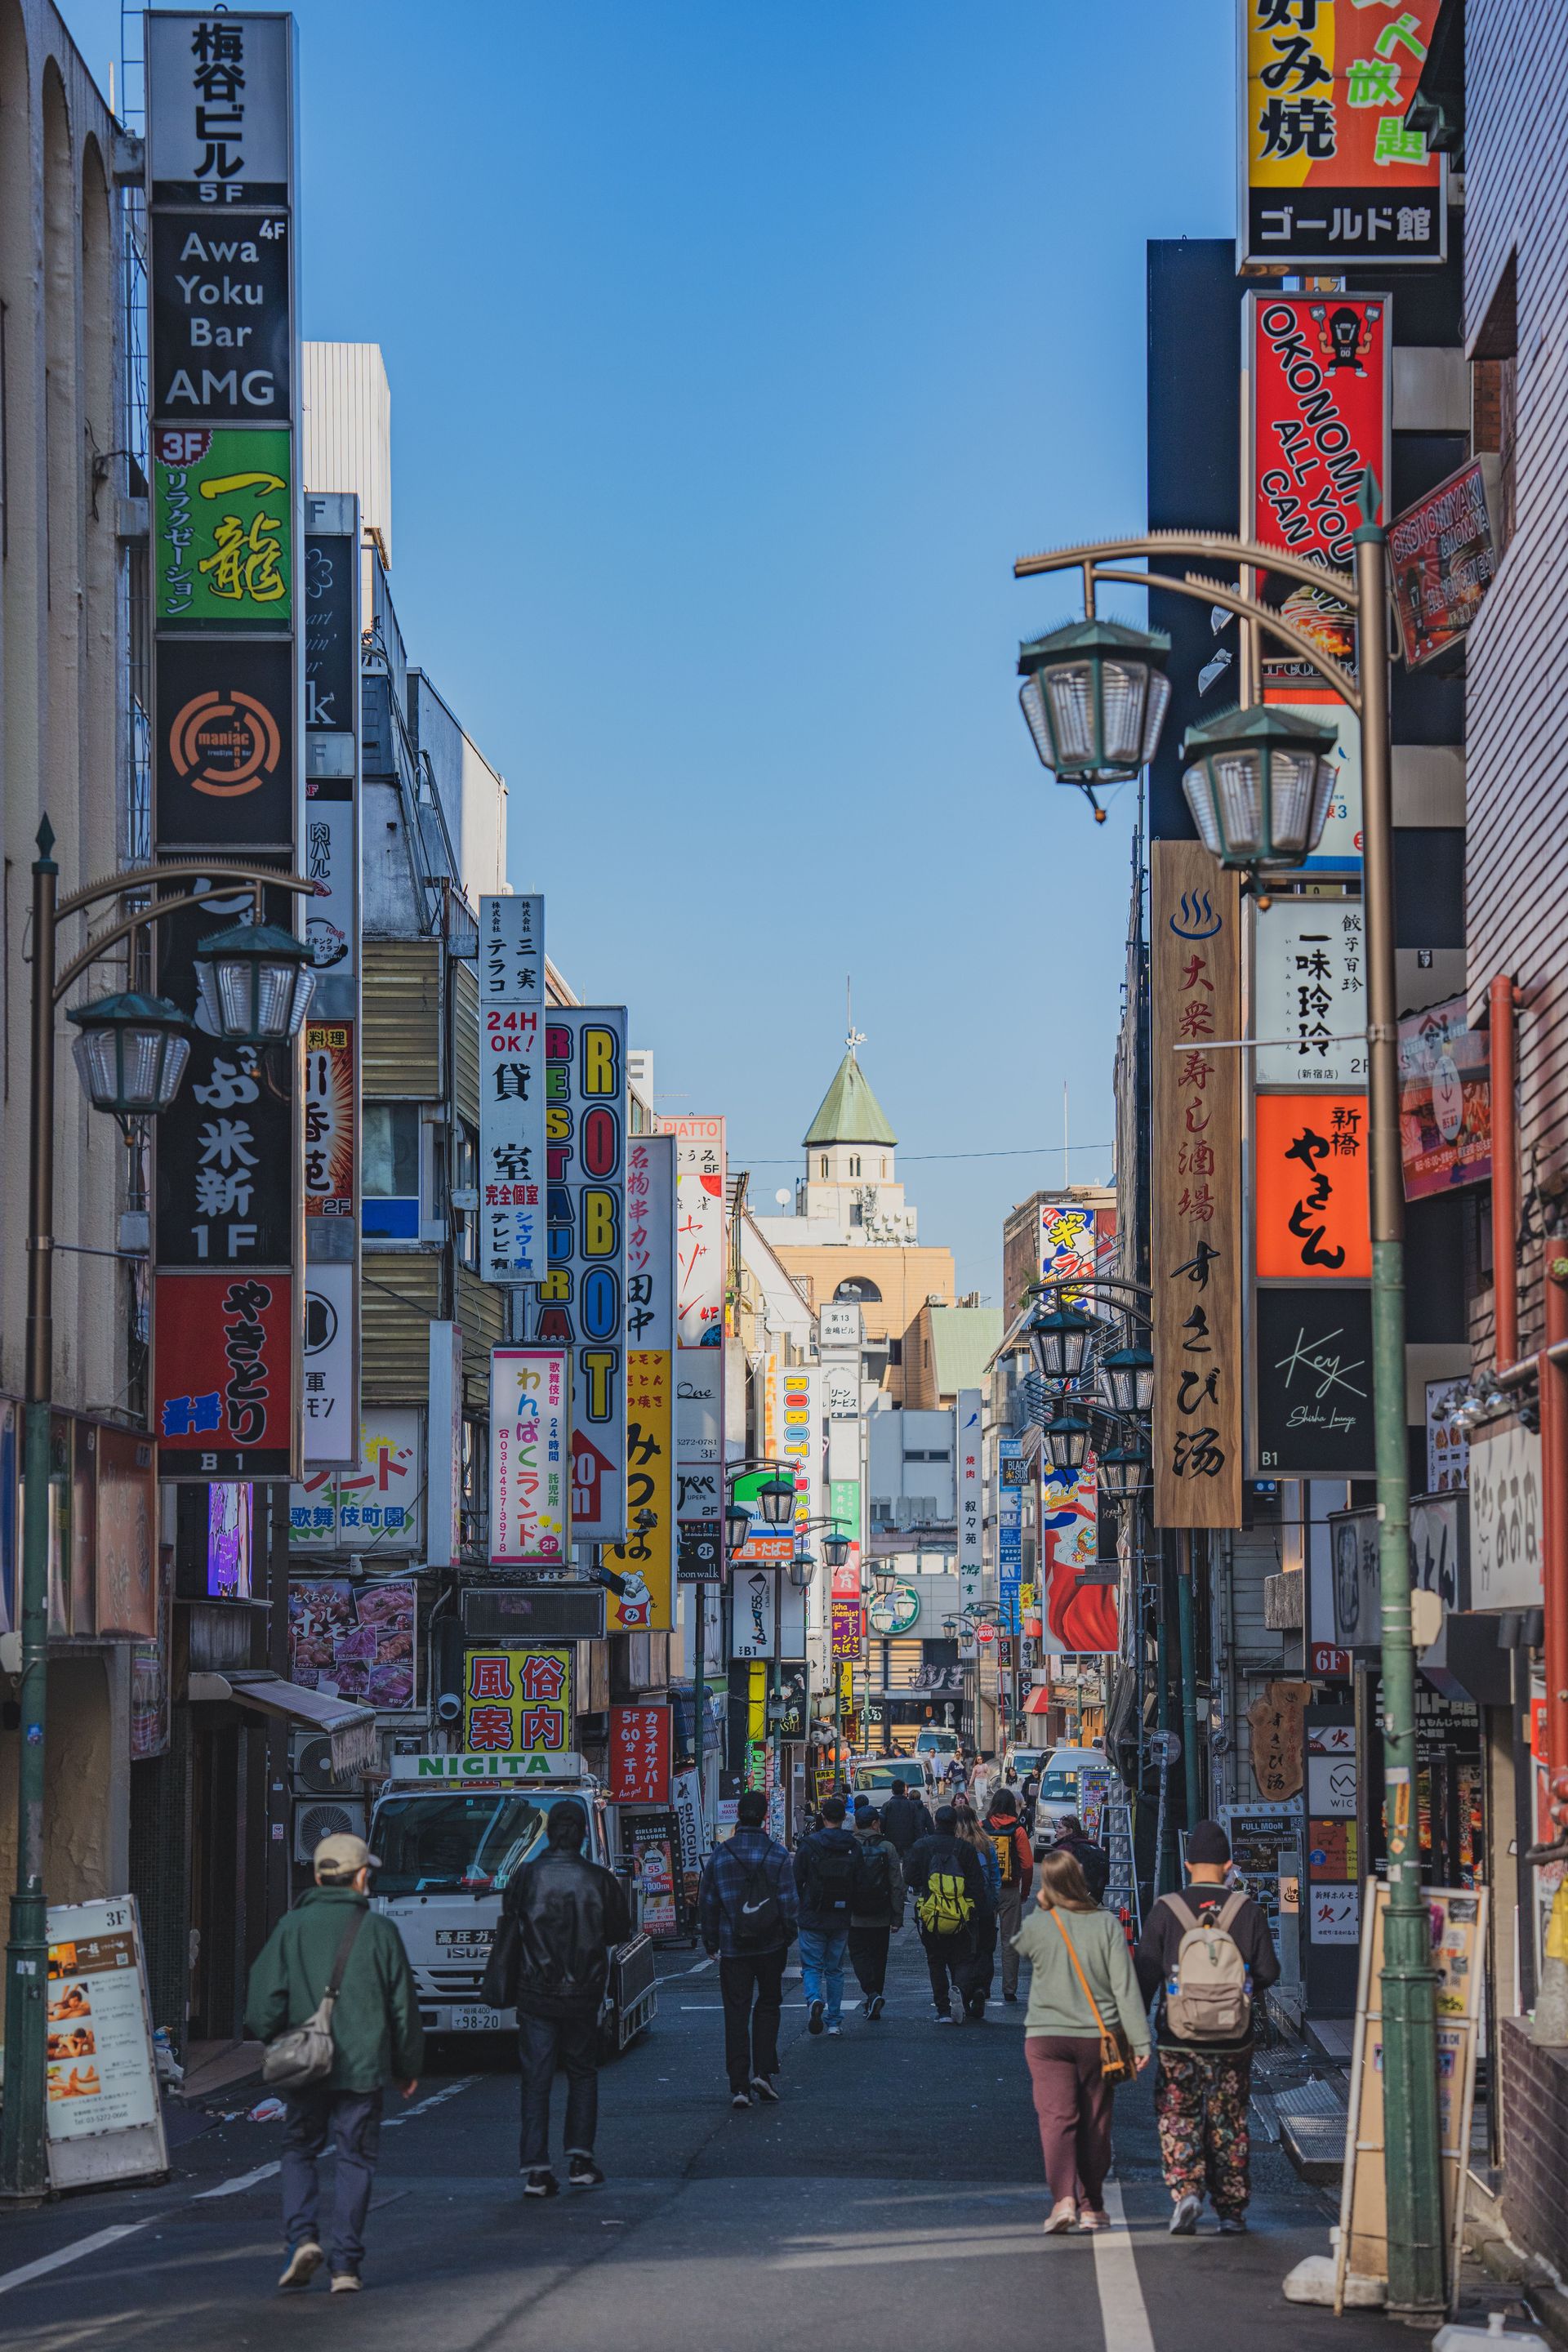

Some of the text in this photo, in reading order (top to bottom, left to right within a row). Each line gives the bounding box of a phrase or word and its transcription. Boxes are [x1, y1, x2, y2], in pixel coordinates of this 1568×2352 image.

[191, 23, 245, 179] 梅谷ビル
[198, 184, 243, 203] 5F
[259, 219, 285, 239] 4F
[1261, 207, 1431, 241] ゴールド館
[180, 232, 259, 263] Awa
[176, 275, 263, 305] Yoku
[190, 318, 252, 348] Bar
[166, 370, 274, 405] AMG
[163, 432, 202, 461] 3F
[1261, 468, 1314, 546] CAN
[1272, 419, 1353, 564] ALL YOU
[1392, 471, 1483, 564] OKONOMIYAKI
[164, 472, 194, 614] リラクゼーション
[199, 471, 287, 603] 一龍
[198, 731, 249, 745] maniac
[310, 822, 330, 879] 肉バル
[523, 901, 532, 933] 株式会社
[487, 901, 507, 992] 株式会社 テラコ
[1341, 913, 1365, 994] 餃子百珍
[1296, 933, 1333, 1057] 一味玲玲
[487, 1012, 537, 1031] 24H
[491, 1035, 534, 1052] OK!
[1177, 955, 1215, 1223] 大衆寿し酒場
[492, 1063, 532, 1181] 貸室
[664, 1122, 718, 1137] PIATTO
[1330, 1107, 1361, 1157] 新橋
[703, 1165, 719, 1173] 5F
[323, 1200, 350, 1215] 2F
[485, 1184, 539, 1206] 完全個室
[1285, 1127, 1345, 1269] やきとん
[581, 1023, 620, 1423] ROBOT
[192, 1225, 256, 1258] 1F
[490, 1213, 510, 1270] テレビ有
[514, 1211, 533, 1270] シャワー有
[627, 1146, 654, 1342] 名物串カツ 田中
[700, 1307, 719, 1321] 4F
[831, 1314, 849, 1322] 第13
[223, 1280, 273, 1444] やきとり
[1169, 1240, 1225, 1480] すさび湯
[1275, 1327, 1367, 1398] Key
[784, 1376, 809, 1457] ROBOT
[1286, 1405, 1326, 1428] Shisha
[548, 1362, 559, 1507] 歌舞伎町 24時間 託児所
[516, 1367, 541, 1546] わんぱくランド
[700, 1449, 716, 1459] 3F
[1008, 1460, 1027, 1470] BLACK
[1263, 1452, 1278, 1466] B1
[1015, 1470, 1028, 1479] SUN
[702, 1506, 718, 1516] 2F
[964, 1455, 977, 1544] 焼肉 叙々苑
[542, 1539, 556, 1550] 2F
[699, 1546, 714, 1556] 2F
[697, 1563, 719, 1578] walk
[292, 1592, 341, 1603] とくちゃん
[292, 1607, 366, 1641] ホルモン
[744, 1646, 757, 1656] B1
[832, 1644, 859, 1653] たばこ
[1316, 1650, 1344, 1672] 6F
[469, 1655, 566, 1701] 風俗
[468, 1704, 565, 1752] 案内
[621, 1710, 639, 1724] 5F
[418, 1756, 550, 1775] NIGITA
[644, 1712, 658, 1798] カラオケバー
[684, 1802, 697, 1868] CHOGUN
[1241, 1822, 1260, 1830] FULL
[106, 1909, 127, 1927] 3F
[438, 1931, 497, 1944] 高圧ガ
[463, 2015, 498, 2029] 98-20
